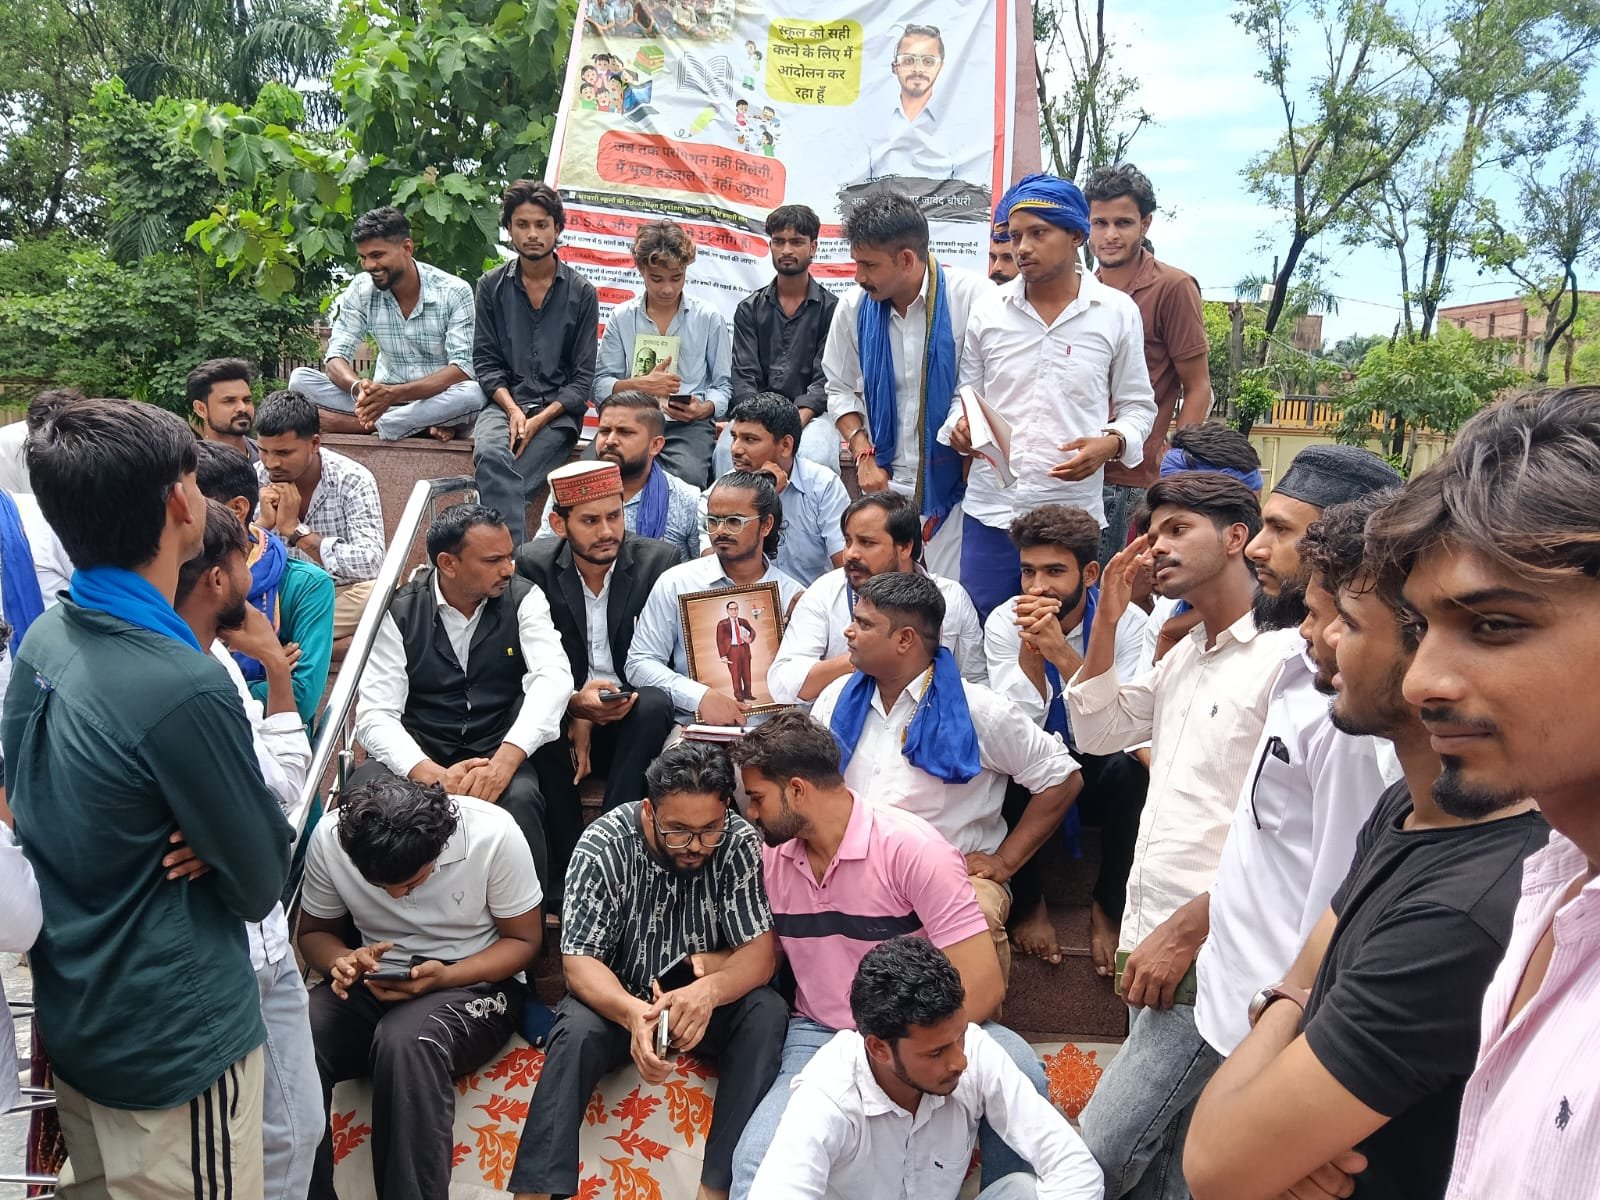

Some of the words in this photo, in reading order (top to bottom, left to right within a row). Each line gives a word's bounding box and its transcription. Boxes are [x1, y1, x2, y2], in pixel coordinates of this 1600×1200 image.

[779, 25, 806, 40] स्कूल
[809, 25, 825, 39] को
[828, 25, 851, 40] सही
[773, 43, 800, 56] करने
[803, 44, 814, 58] के
[817, 45, 840, 61] लिए
[778, 64, 825, 79] आंदोलन
[827, 69, 846, 79] कर
[795, 87, 813, 100] रहा
[711, 155, 732, 170] नहीं
[711, 176, 733, 191] नहीं
[626, 199, 659, 209] Education
[659, 203, 684, 212] System
